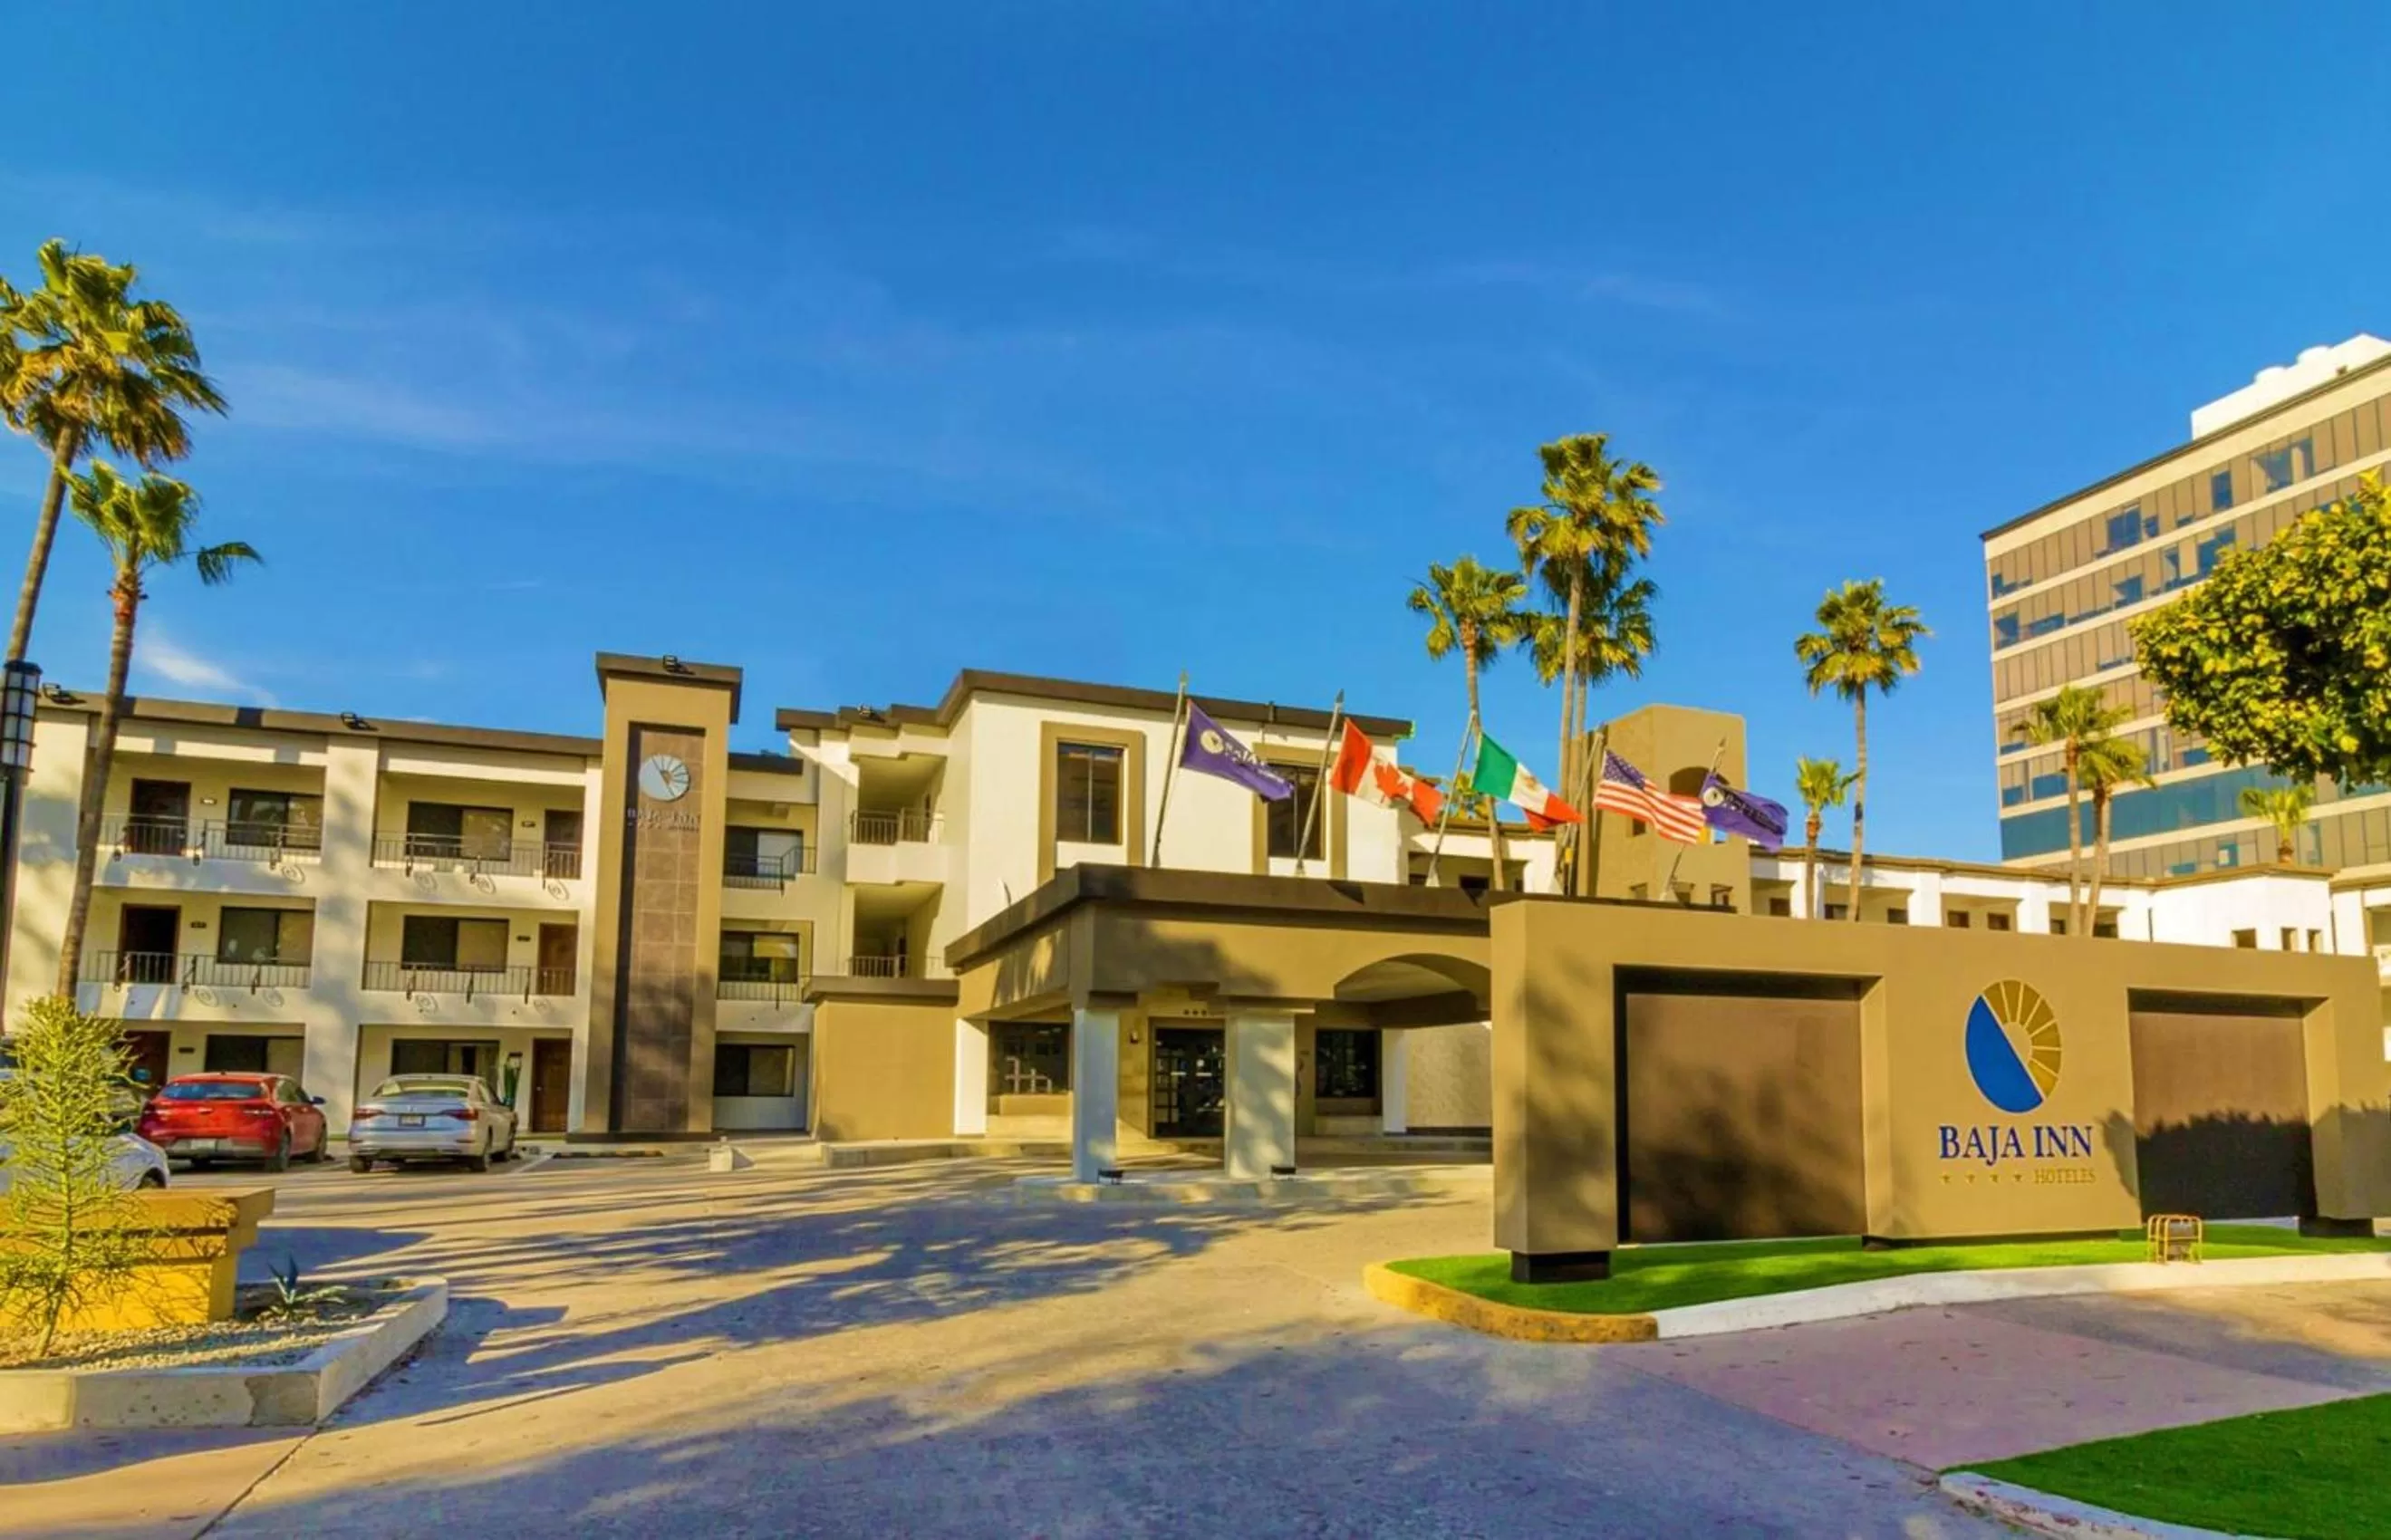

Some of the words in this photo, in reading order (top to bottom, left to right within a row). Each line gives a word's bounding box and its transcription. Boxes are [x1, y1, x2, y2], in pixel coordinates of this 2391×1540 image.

[1939, 1125, 2025, 1166] BAJA
[2033, 1125, 2093, 1158] INN
[2034, 1168, 2096, 1184] HOTELES
